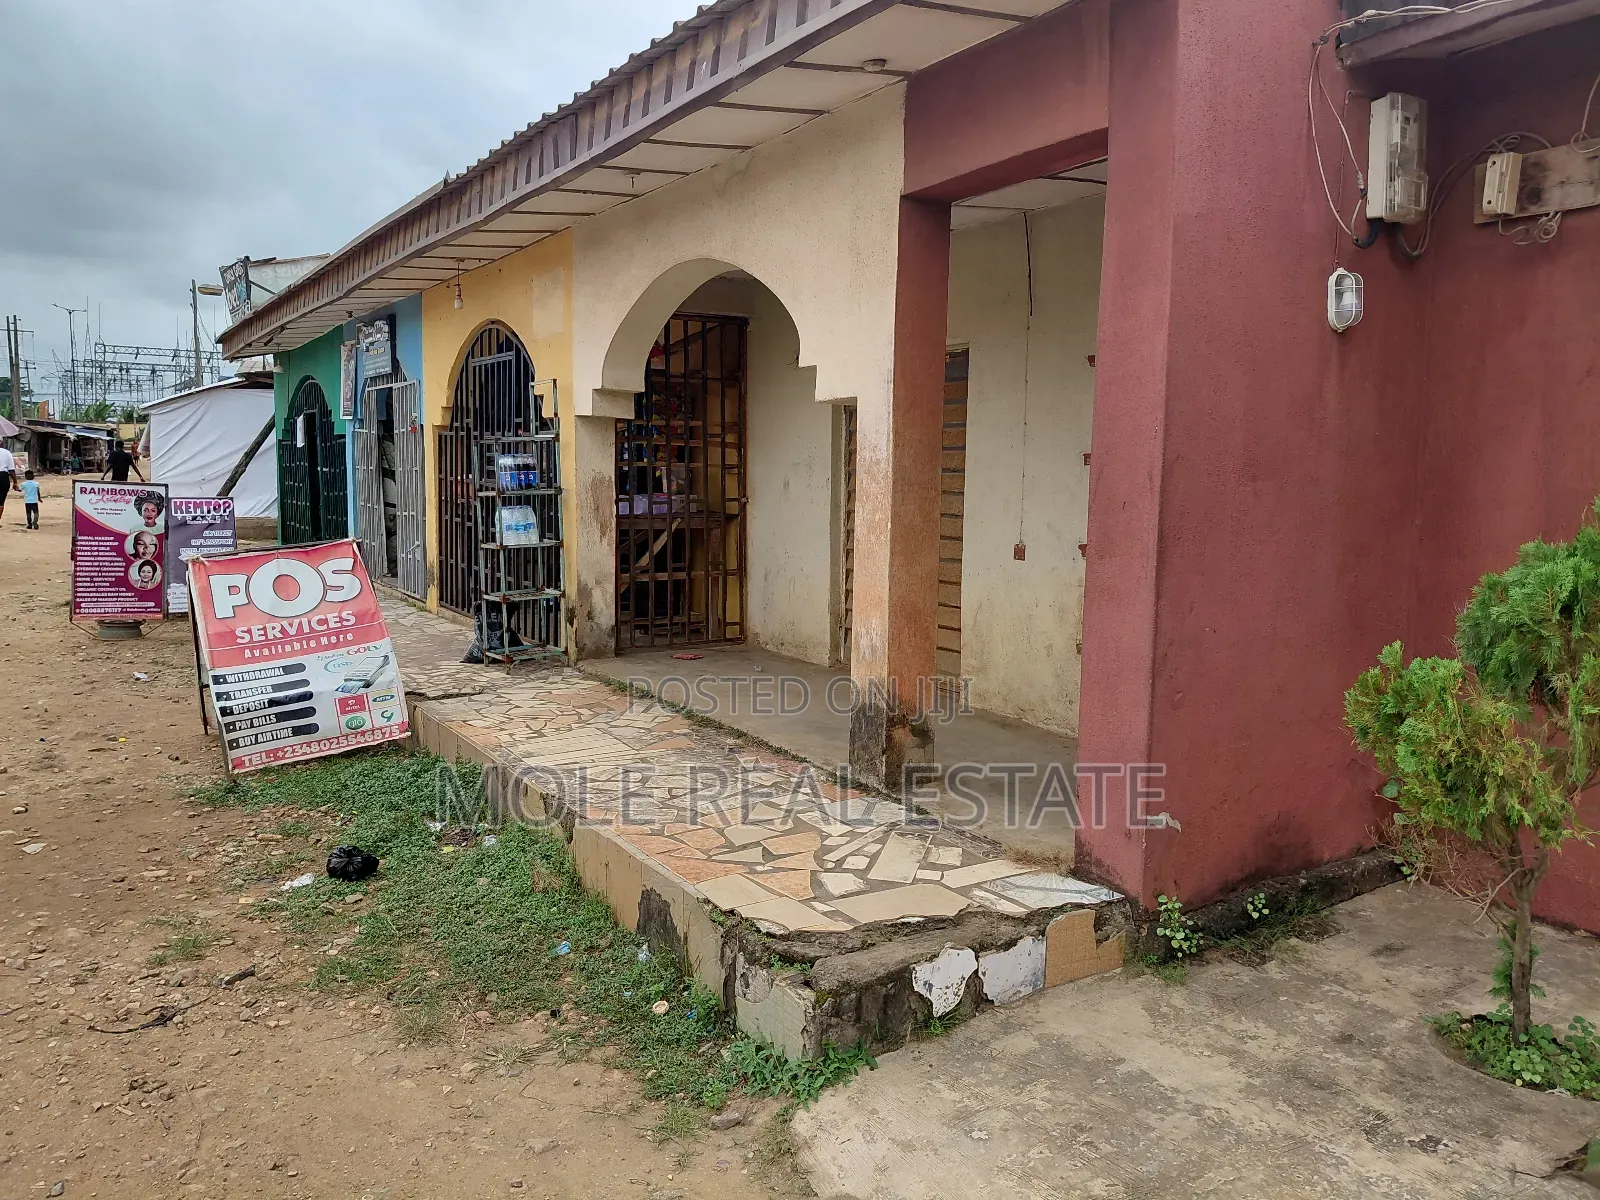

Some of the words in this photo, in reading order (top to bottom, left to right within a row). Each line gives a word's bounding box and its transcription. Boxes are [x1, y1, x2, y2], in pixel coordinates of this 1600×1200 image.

[80, 486, 147, 497] RAINBOWS
[172, 499, 232, 516] KEMTOP
[208, 557, 363, 619] POS
[235, 611, 357, 644] SERVICES
[244, 639, 318, 659] Available
[320, 632, 355, 646] Here
[225, 668, 286, 684] WITHDRAWAL
[229, 685, 273, 700] TRANSFER
[376, 695, 391, 703] MTN
[232, 699, 270, 715] DEPOSIT
[345, 704, 361, 712] airtel
[235, 719, 252, 731] PAY
[252, 715, 277, 727] BILLS
[348, 719, 363, 728] glo
[238, 735, 256, 747] BUY
[257, 728, 294, 743] AIRTIME
[242, 751, 275, 767] TEL:
[276, 726, 400, 759] +2348025546875
